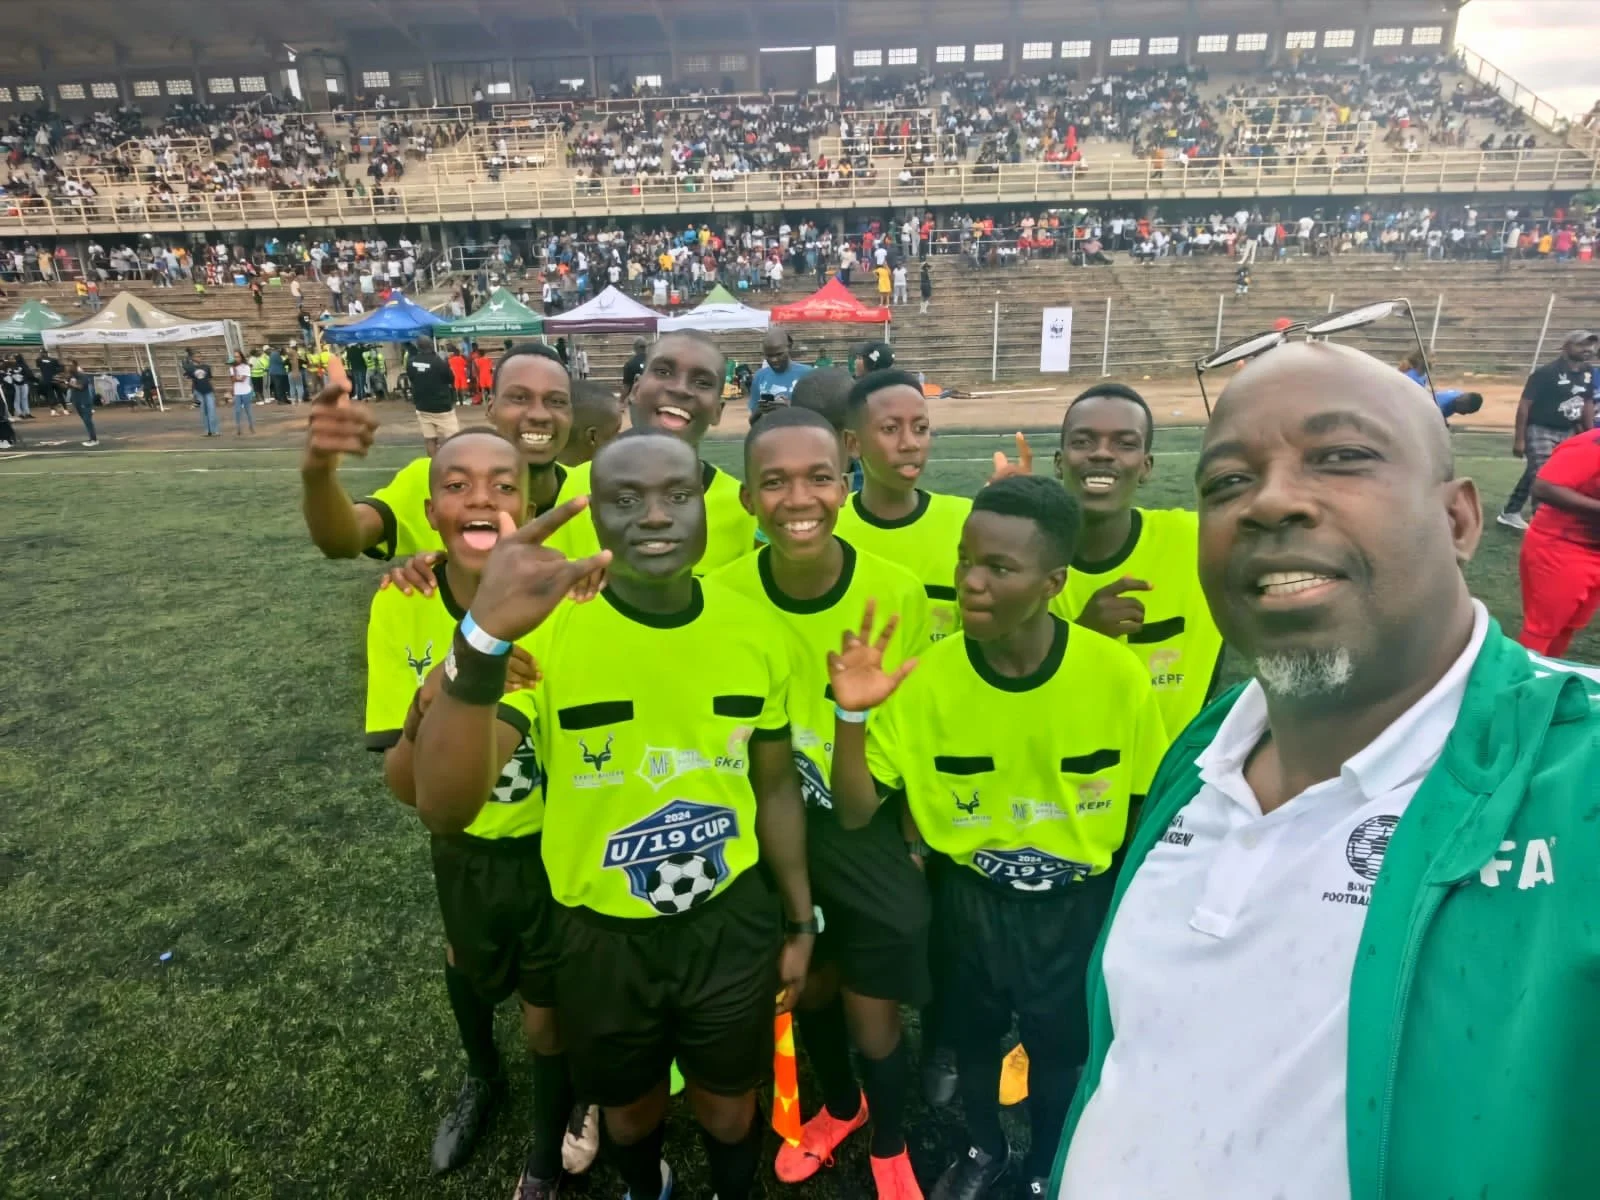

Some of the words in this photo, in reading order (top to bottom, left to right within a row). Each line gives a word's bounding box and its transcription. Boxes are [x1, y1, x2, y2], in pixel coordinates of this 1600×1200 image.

[664, 811, 691, 823] 2024
[610, 832, 686, 862] U/19
[692, 818, 730, 843] CUP
